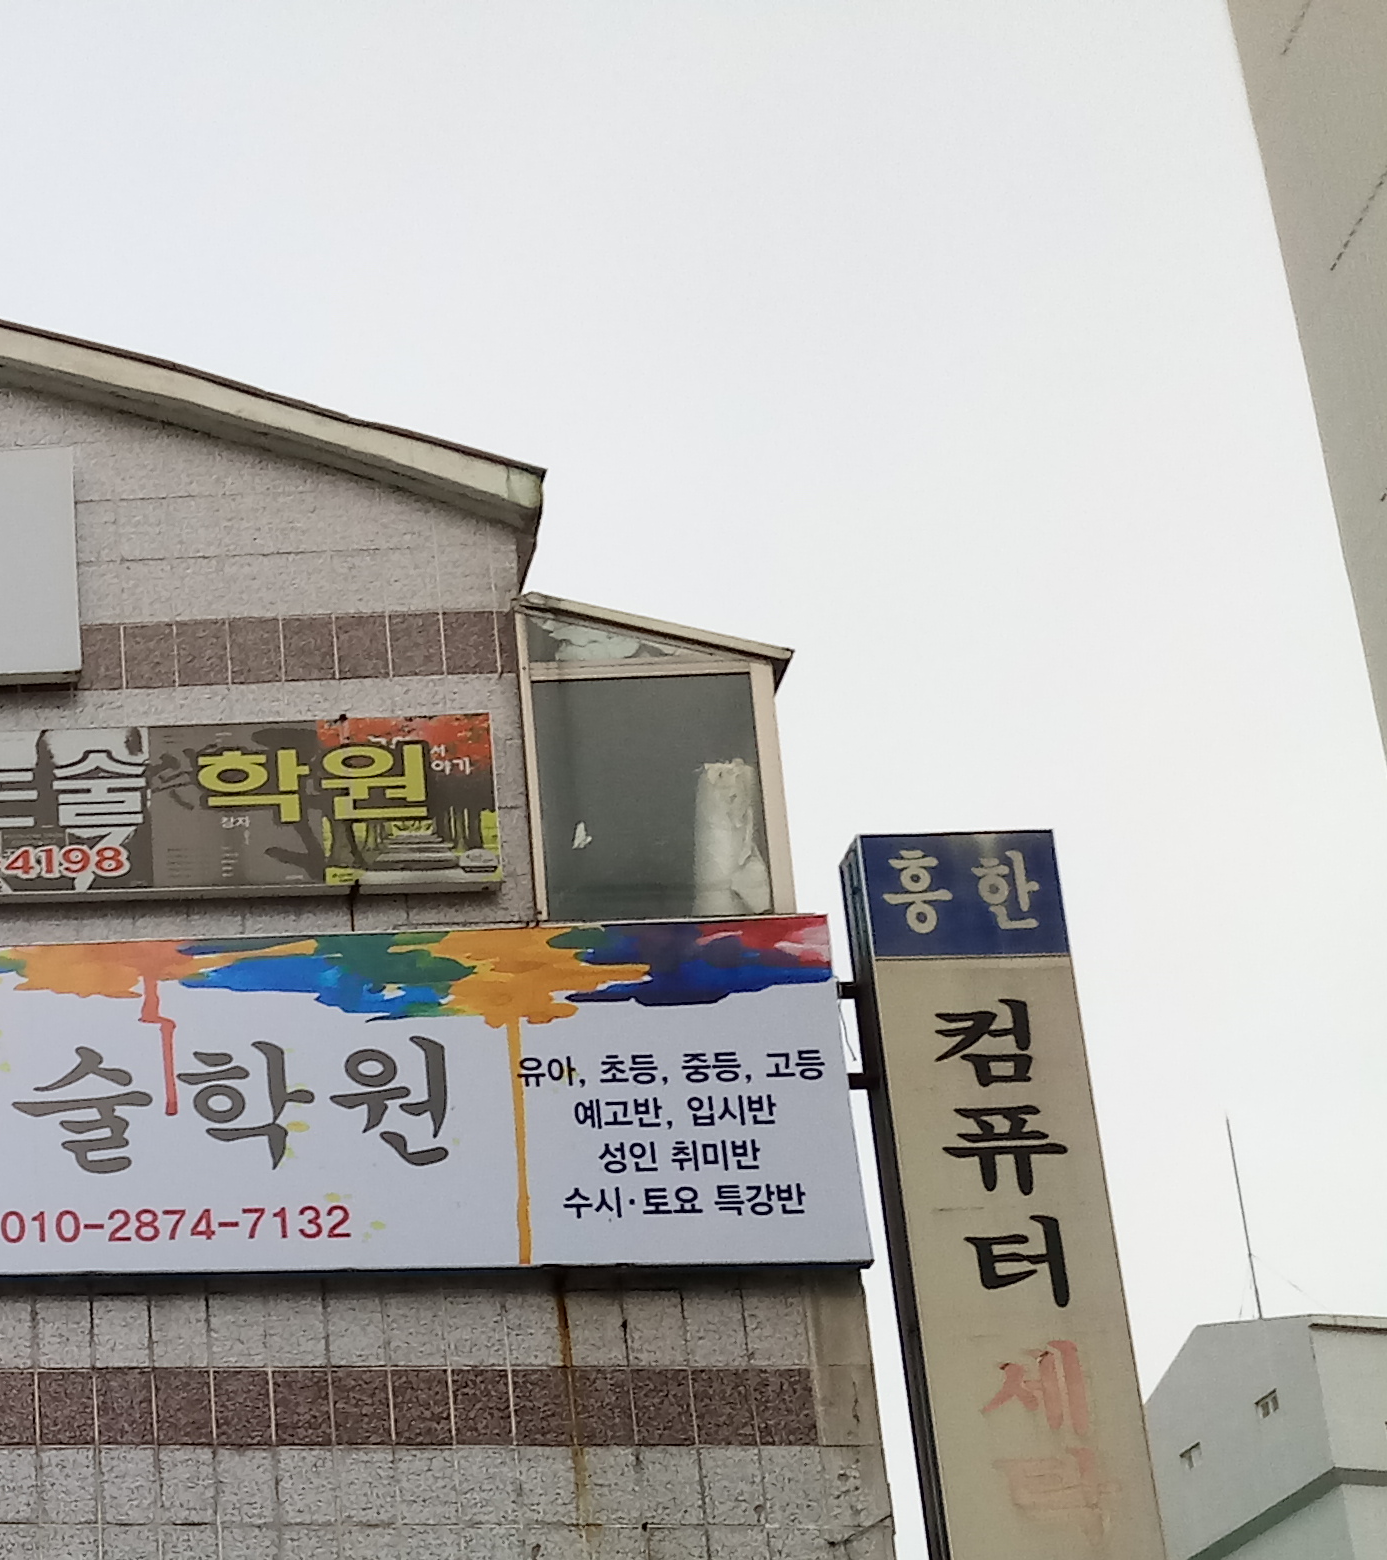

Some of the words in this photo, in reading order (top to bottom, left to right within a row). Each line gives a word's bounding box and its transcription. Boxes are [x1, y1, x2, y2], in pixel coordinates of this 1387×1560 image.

[517, 1055, 587, 1089] 유아,
[598, 1053, 669, 1086] 초등,
[680, 1051, 752, 1084] 중등,
[765, 1049, 826, 1081] 고등
[573, 1096, 674, 1130] 예고반,
[686, 1093, 778, 1127] 입시반
[597, 1140, 660, 1175] 성인
[670, 1138, 762, 1172] 취미반
[713, 1182, 807, 1217] 특강반
[0, 1203, 352, 1247] 010-2874-7132
